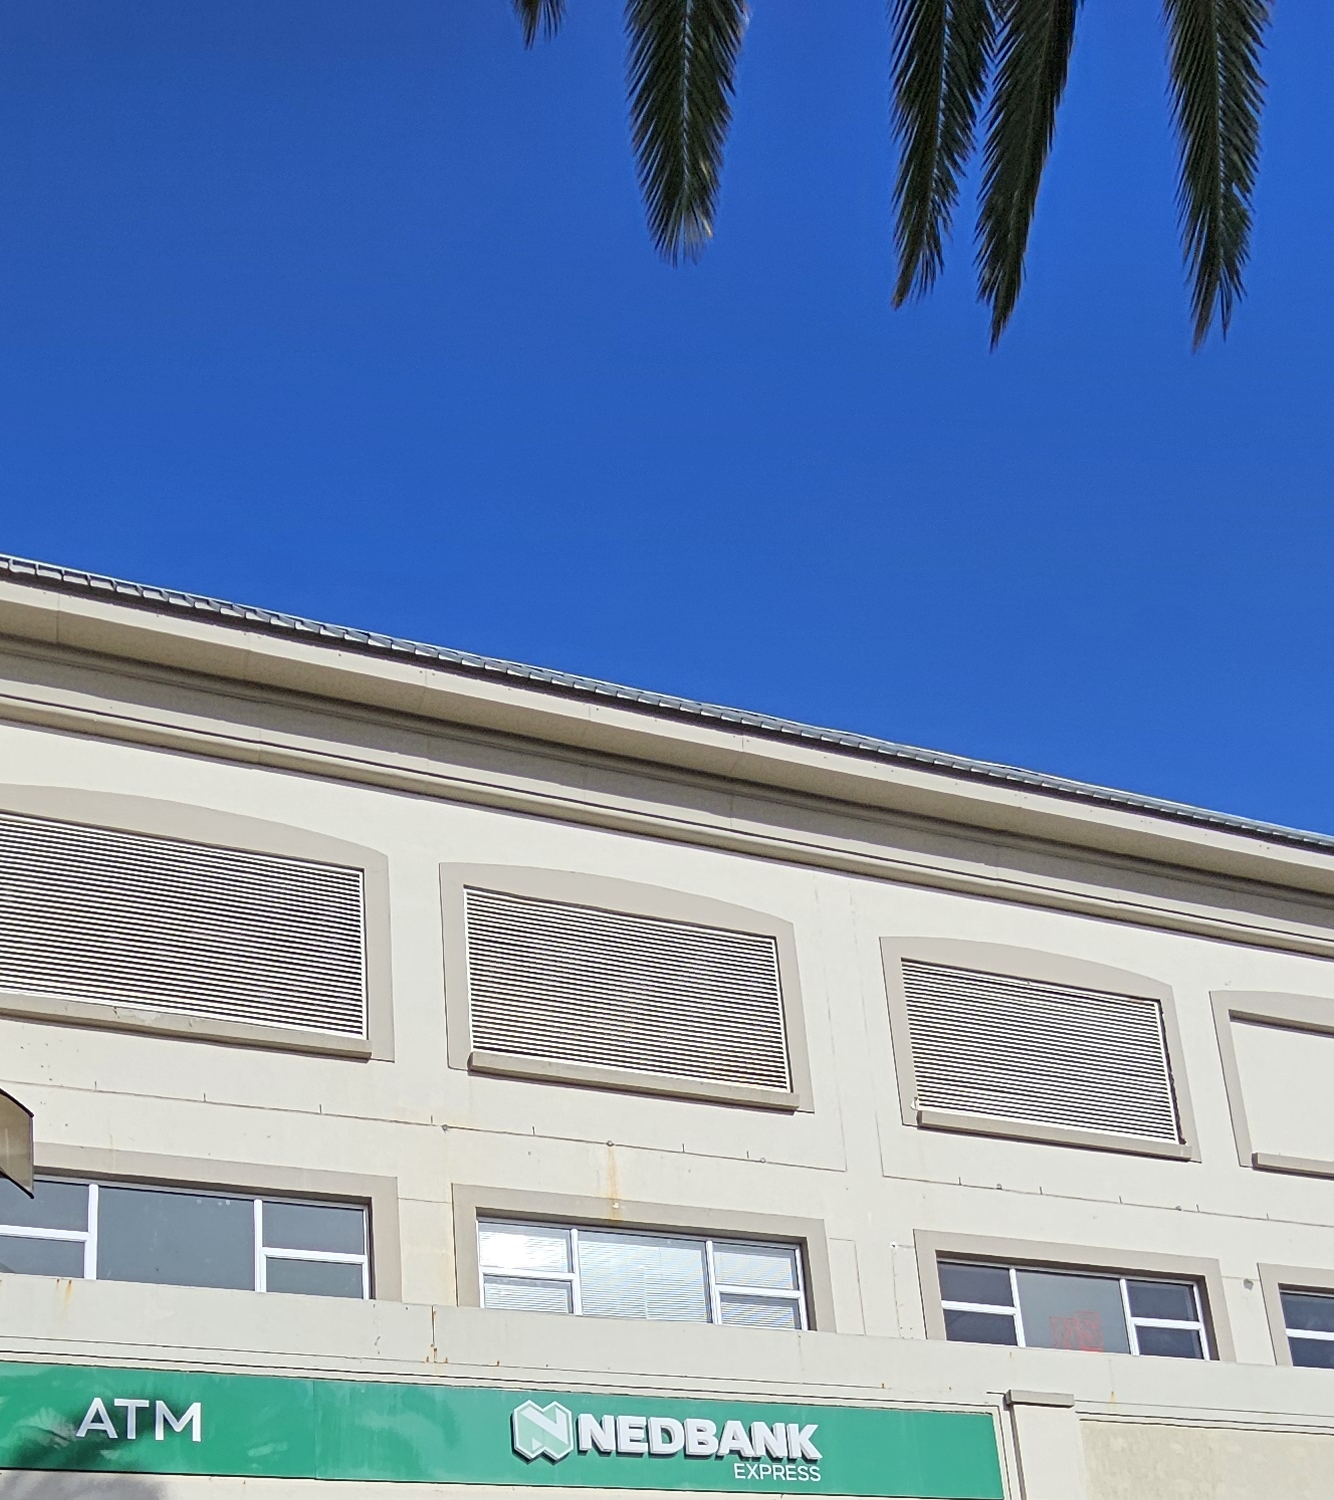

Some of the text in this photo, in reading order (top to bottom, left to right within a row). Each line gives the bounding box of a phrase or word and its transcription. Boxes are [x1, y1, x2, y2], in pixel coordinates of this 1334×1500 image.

[75, 1397, 202, 1442] ATM
[577, 1413, 823, 1461] NEDBANK
[733, 1463, 822, 1482] EXPRESS
